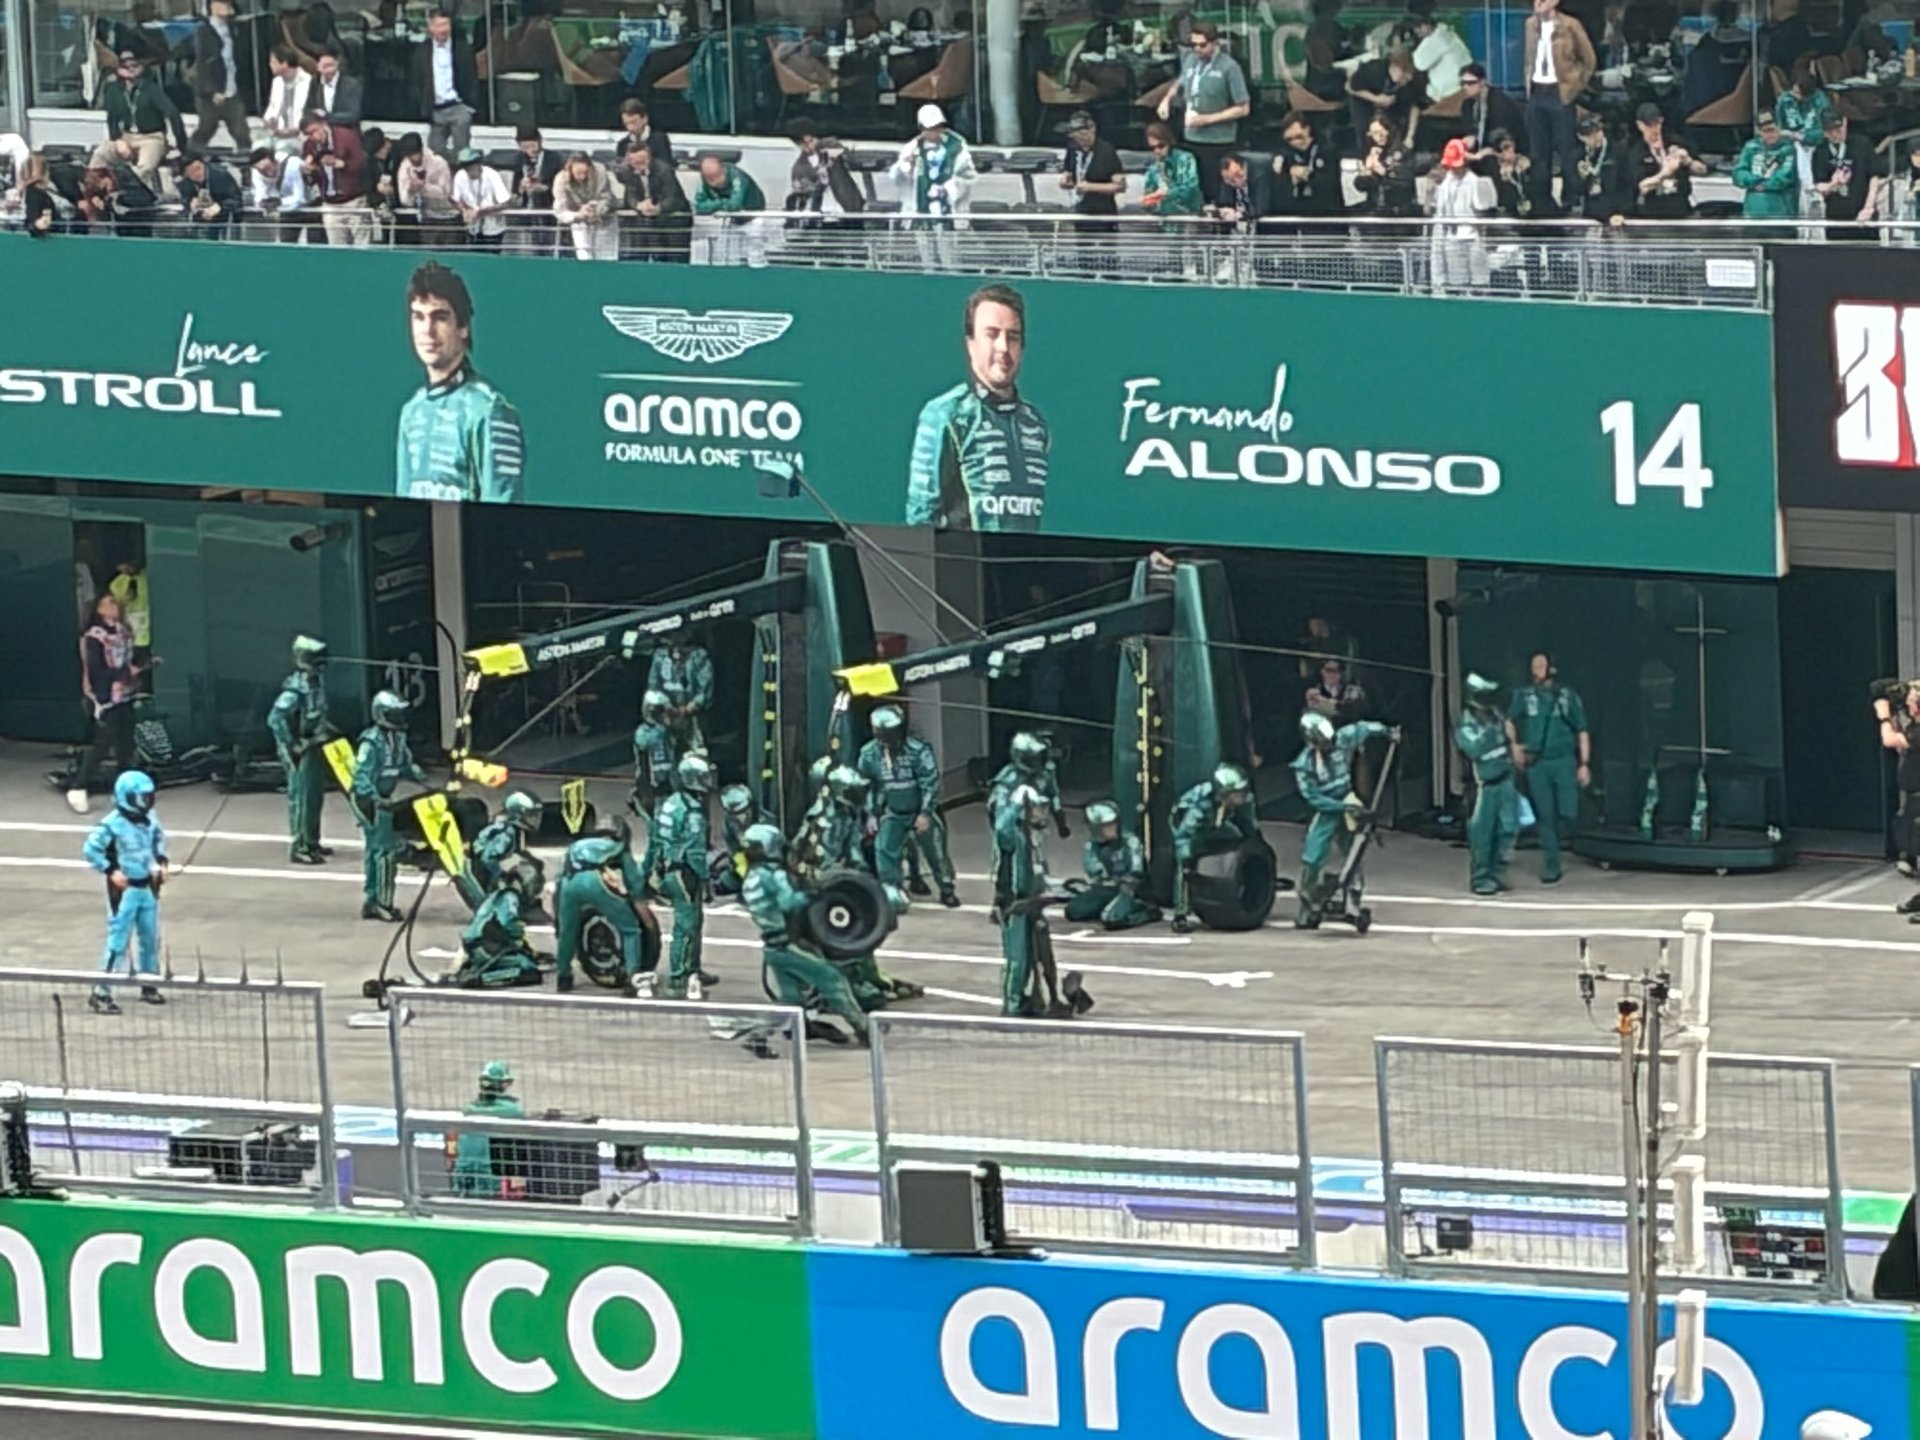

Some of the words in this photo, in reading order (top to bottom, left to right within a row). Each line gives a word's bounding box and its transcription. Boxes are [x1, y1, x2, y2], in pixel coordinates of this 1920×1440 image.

[175, 312, 270, 377] Lance
[0, 369, 283, 418] STROLL
[604, 393, 802, 441] aramco
[1120, 363, 1294, 443] Fernando
[605, 442, 697, 466] FORMULA
[700, 447, 741, 468] ONE
[1125, 438, 1501, 496] ALONSO
[1600, 400, 1713, 508] 14
[940, 1286, 1764, 1440] aramco
